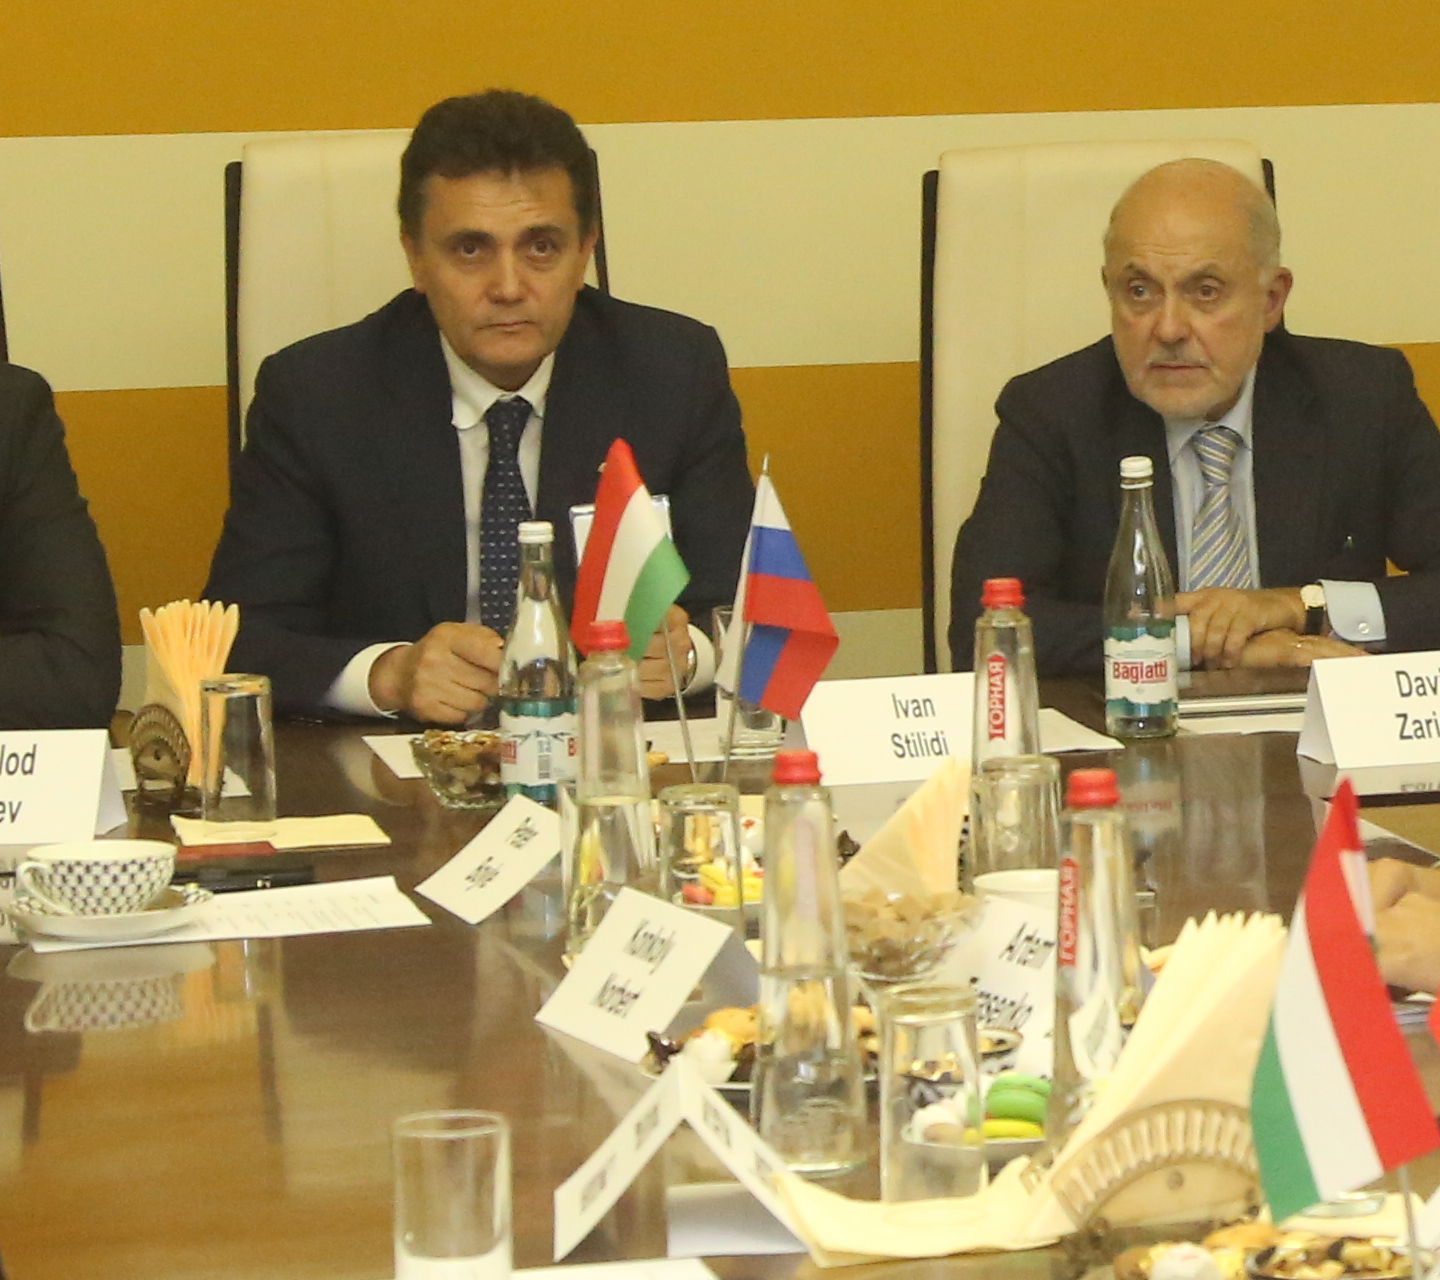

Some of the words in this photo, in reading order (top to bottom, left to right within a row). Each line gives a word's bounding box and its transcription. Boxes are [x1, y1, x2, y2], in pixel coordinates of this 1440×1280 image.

[891, 692, 936, 719] Ivan
[989, 661, 1005, 734] ГОРНАЯ
[891, 730, 950, 759] Stilidi
